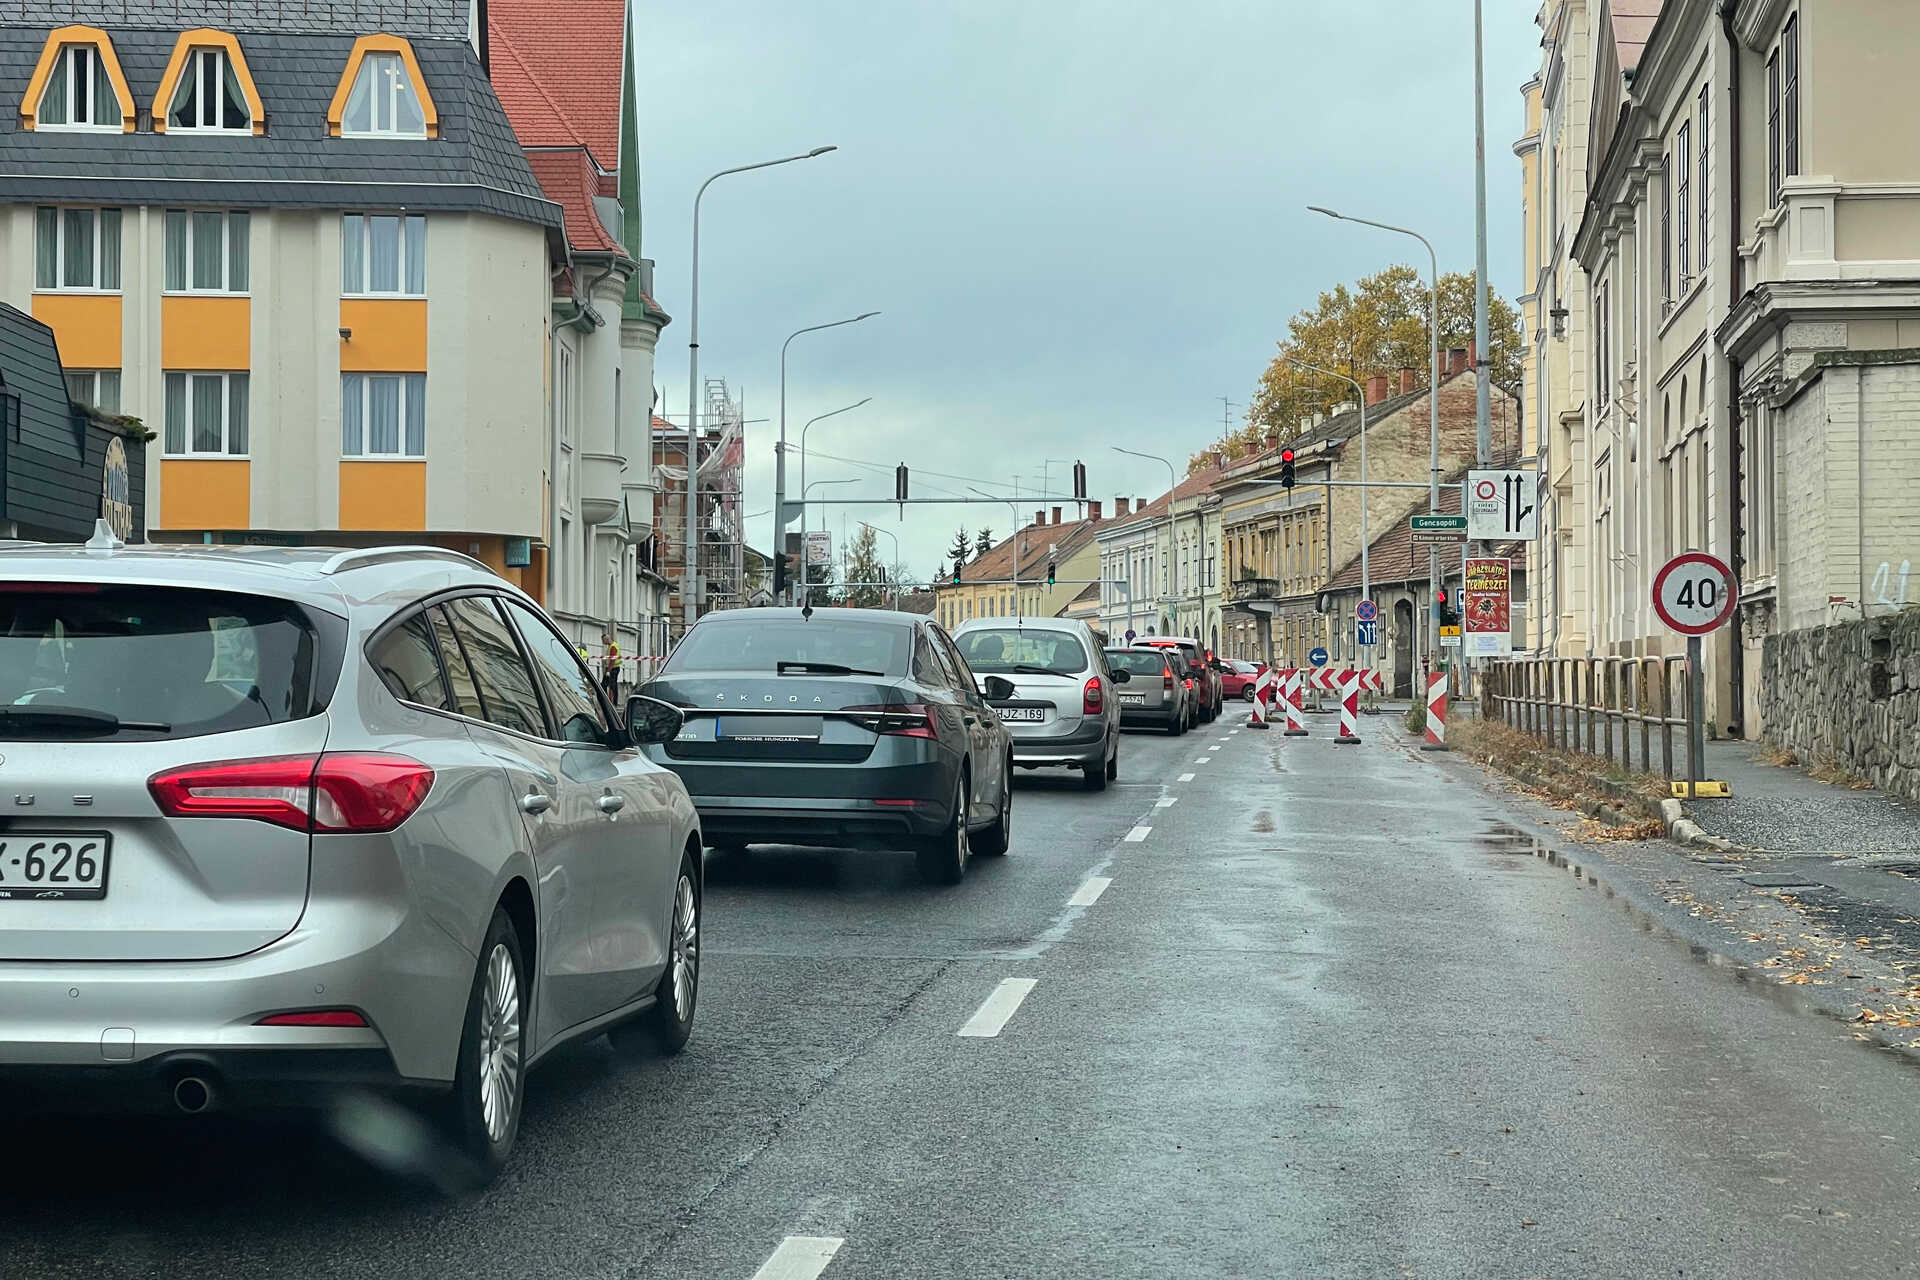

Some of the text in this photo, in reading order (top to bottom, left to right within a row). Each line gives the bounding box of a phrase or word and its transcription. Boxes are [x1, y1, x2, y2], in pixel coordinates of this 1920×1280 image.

[1418, 518, 1457, 528] Gencsapáti
[1466, 576, 1508, 591] TERMÉSZET
[1676, 578, 1716, 609] 40
[997, 708, 1044, 720] HJZ-169
